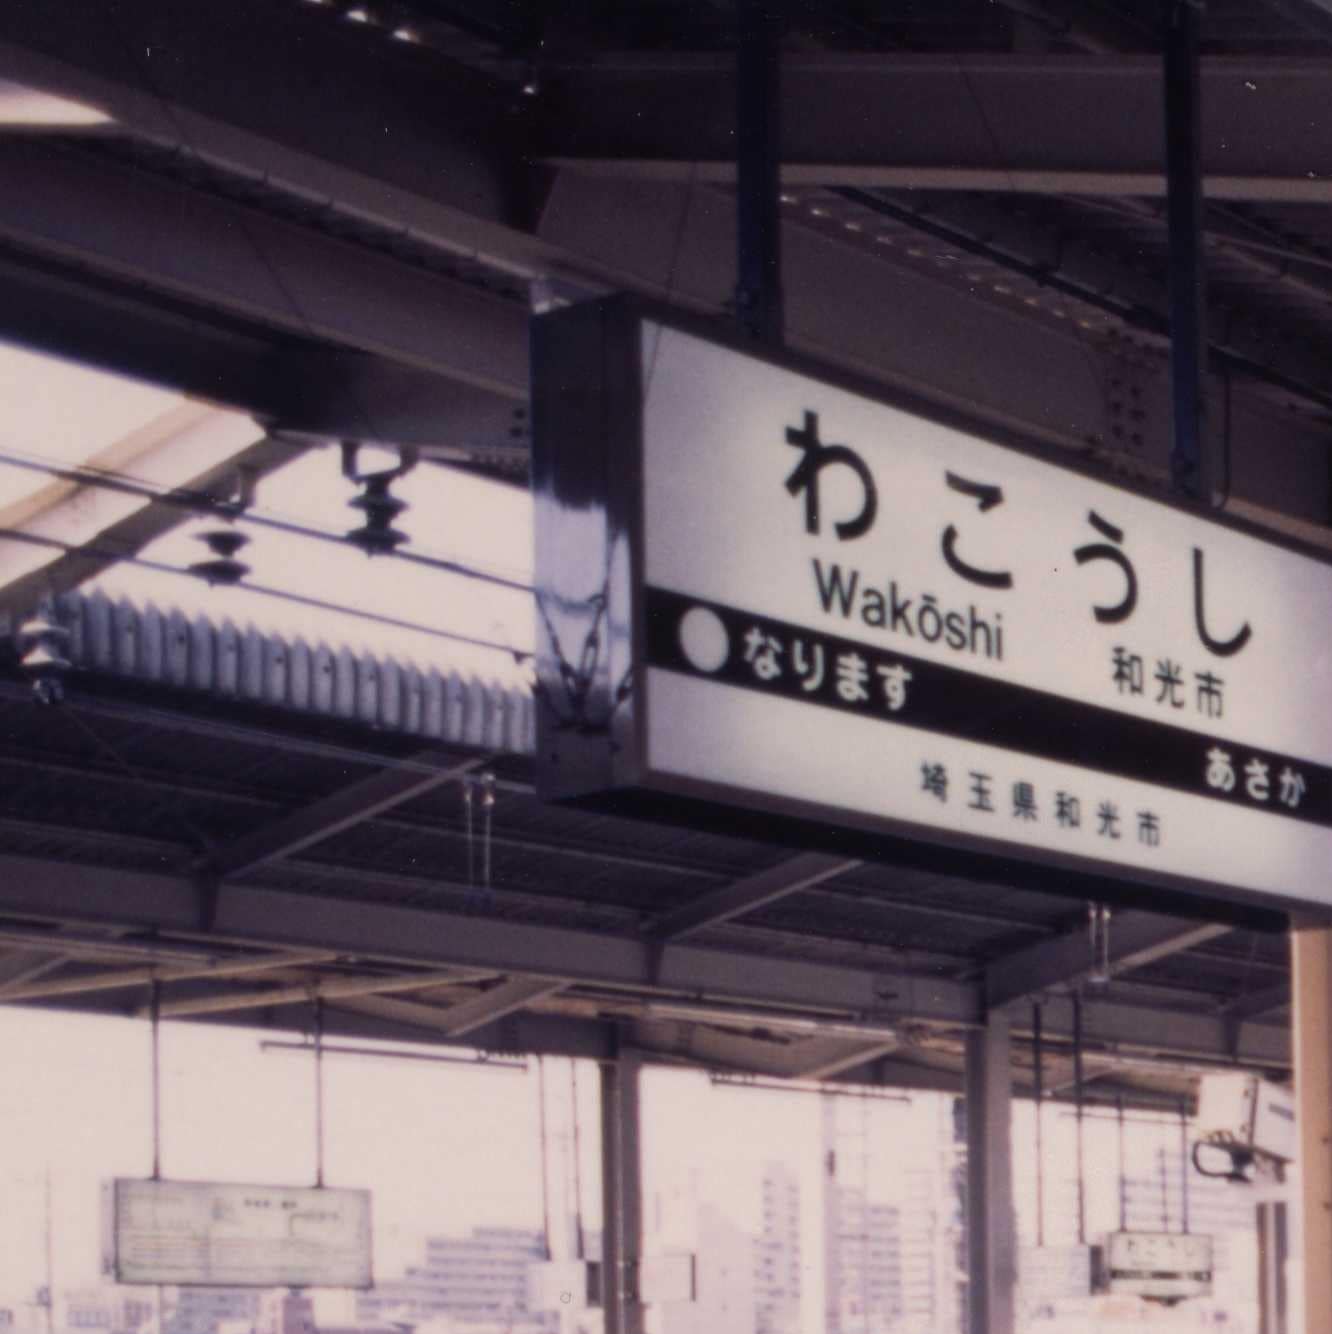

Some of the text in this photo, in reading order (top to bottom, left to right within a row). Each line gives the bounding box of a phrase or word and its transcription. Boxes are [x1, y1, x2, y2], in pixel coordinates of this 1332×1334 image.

[783, 408, 1254, 659] わこうし
[811, 557, 1005, 661] Wakōshi
[742, 624, 913, 710] なります
[1110, 644, 1225, 721] 和光市
[919, 761, 1163, 849] 埼玉県和光市
[1204, 746, 1307, 810] あさか
